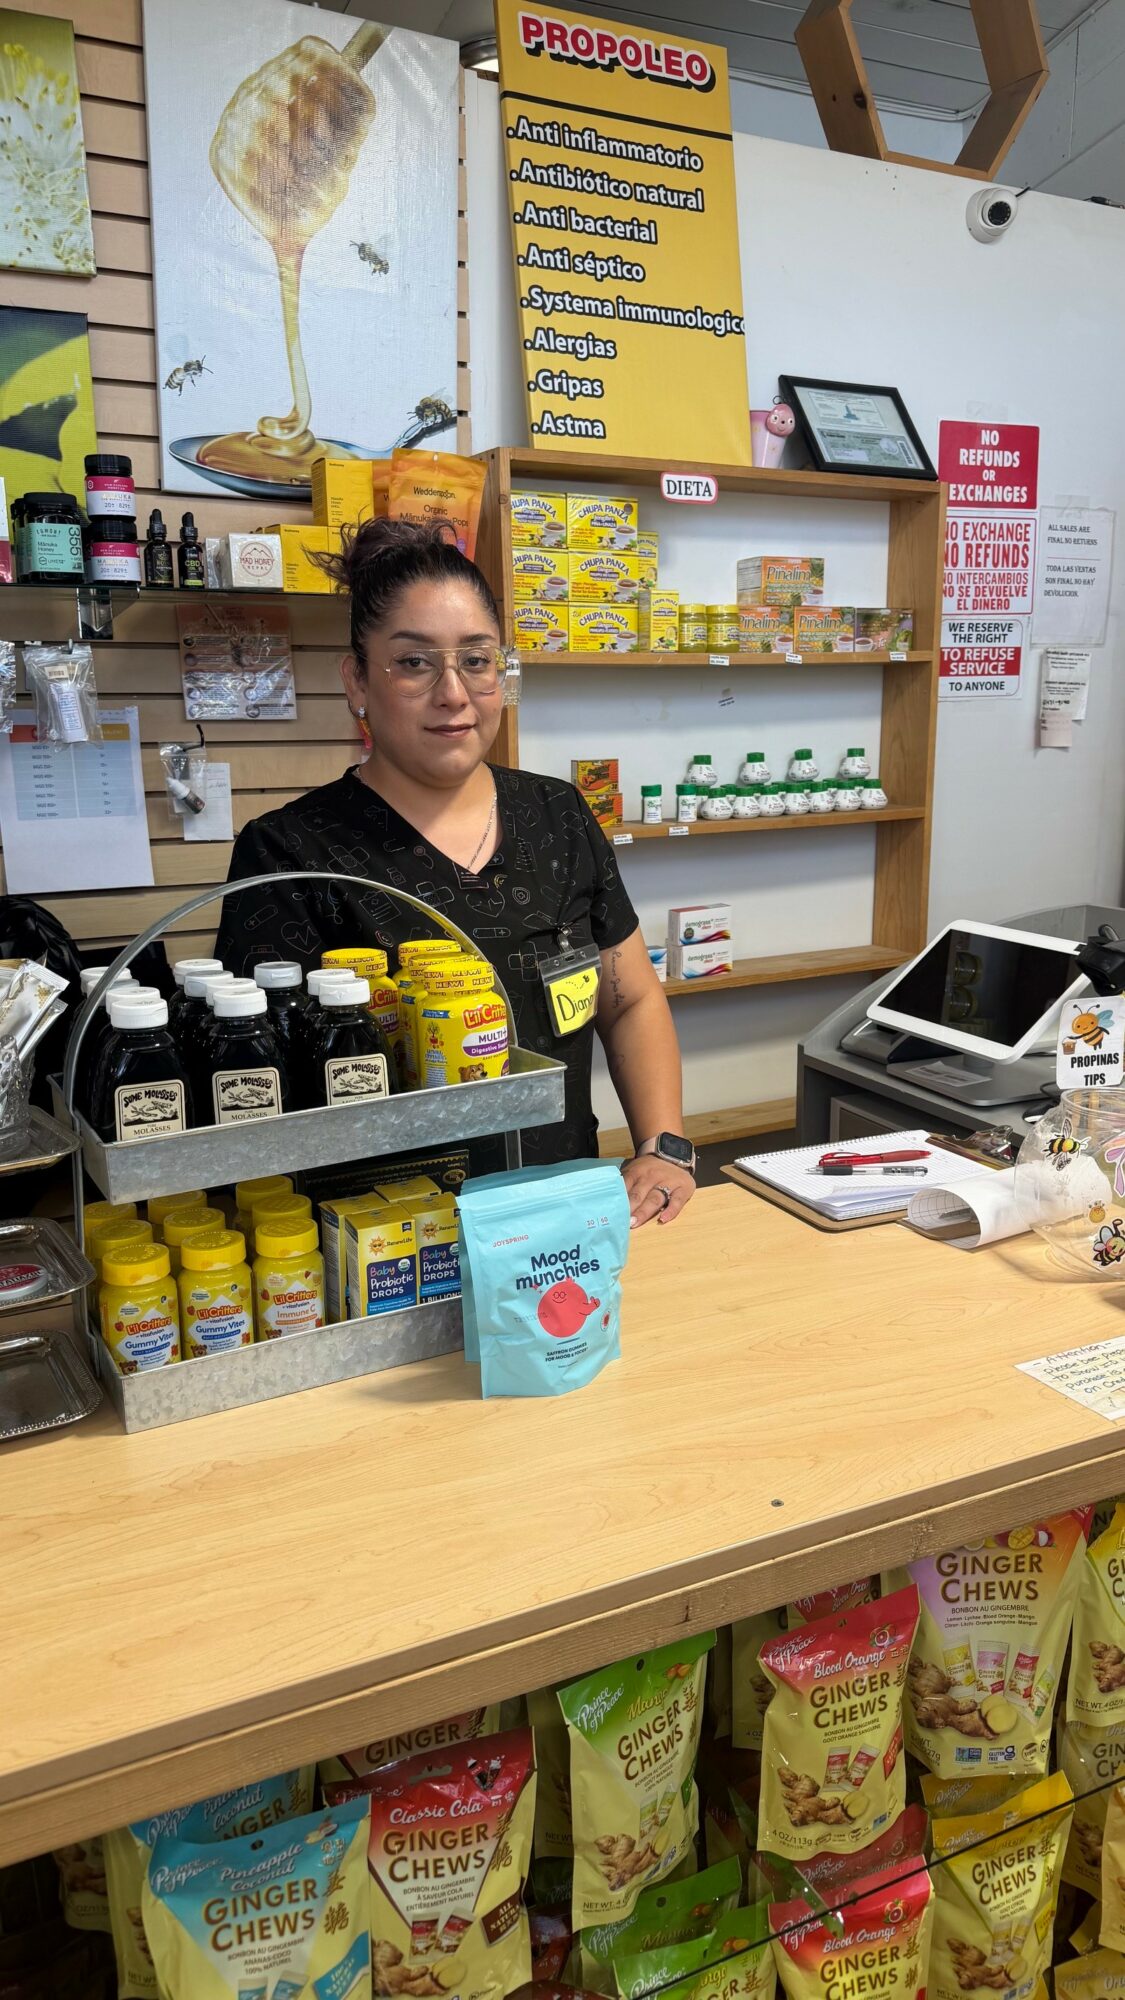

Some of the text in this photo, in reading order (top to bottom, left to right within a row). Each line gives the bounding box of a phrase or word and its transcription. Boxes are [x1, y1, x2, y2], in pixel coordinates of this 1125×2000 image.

[518, 12, 715, 92] PROPOLEO
[563, 130, 703, 172] inflammatorio
[635, 183, 704, 212] natural
[570, 208, 657, 244] bacterial
[573, 251, 646, 282] séptico
[981, 429, 1000, 446] NO
[959, 449, 1020, 468] REFUNDS
[982, 470, 996, 481] OR
[666, 479, 713, 498] DIETA
[949, 484, 1027, 503] EXCHANGES
[578, 504, 602, 519] CHUPA
[962, 521, 1031, 542] EXCHANGE
[535, 554, 557, 571] PANZA
[964, 544, 1029, 568] REFUNDS
[579, 557, 604, 571] CHUPA
[606, 557, 630, 576] PANZA
[956, 572, 1029, 585] INTERCAMBIOS
[957, 585, 1027, 598] SE DEVUELVE
[957, 598, 1010, 611] EL DINERO
[579, 611, 629, 629] CHUPA PANZA
[948, 622, 1014, 633] WE RESERVE
[953, 633, 1008, 644] THE RIGHT
[942, 648, 1015, 661] TO REFUSE
[950, 662, 1005, 675] SERVICE
[948, 680, 1005, 691] TO ANYONE
[471, 1044, 497, 1054] Digestive
[1070, 1052, 1119, 1068] PROPINAS
[332, 1061, 381, 1080] SOME MOLASSES
[1084, 1073, 1106, 1086] TIPS
[220, 1075, 273, 1093] SOME MOLASSES
[123, 1089, 178, 1107] SOME MOLASSES
[231, 1111, 268, 1121] MOLASSES
[133, 1125, 171, 1136] MOLASSES
[492, 1234, 529, 1249] JOYSPRING
[422, 1249, 447, 1261] Baby
[530, 1244, 581, 1272] Mood
[370, 1266, 396, 1279] Baby
[423, 1269, 455, 1282] DROPS
[516, 1258, 600, 1291] munchies
[370, 1274, 414, 1291] Probiotic
[286, 1290, 317, 1303] Critters
[371, 1287, 404, 1299] DROPS
[208, 1305, 242, 1318] Critters
[277, 1304, 316, 1318] Immune C
[140, 1317, 172, 1333] Critters
[196, 1320, 246, 1335] Gummy Vites
[125, 1332, 174, 1350] Gummy Vites
[935, 1552, 1043, 1578] GINGER
[941, 1579, 1040, 1604] CHEWS
[951, 1606, 979, 1614] BONBON
[990, 1604, 1029, 1613] GINGEMBRE
[814, 1650, 886, 1678] Blood Orange
[809, 1671, 890, 1708] GINGER
[627, 1687, 670, 1721] Mango
[813, 1695, 888, 1728] CHEWS
[618, 1699, 681, 1760] GINGER
[364, 1722, 461, 1765] GINGER
[625, 1723, 683, 1781] CHEWS
[213, 1785, 264, 1831] Coconut
[390, 1799, 484, 1824] Classic Cola
[383, 1822, 489, 1856] GINGER
[220, 1843, 304, 1882] Pineapple
[388, 1849, 485, 1883] CHEWS
[972, 1845, 1036, 1885] GINGER
[231, 1860, 295, 1891] Coconut
[979, 1865, 1037, 1905] CHEWS
[403, 1876, 476, 1895] BONBON AU GINGEMBRE
[422, 1891, 446, 1901] SAVEUR
[447, 1887, 463, 1896] COLA
[203, 1878, 318, 1925] GINGER
[448, 1892, 475, 1903] NATUREL
[210, 1909, 316, 1952] CHEWS
[823, 1927, 896, 1953] Blood Orange
[820, 1946, 900, 1983] GINGER
[825, 1968, 898, 2000] CHEWS
